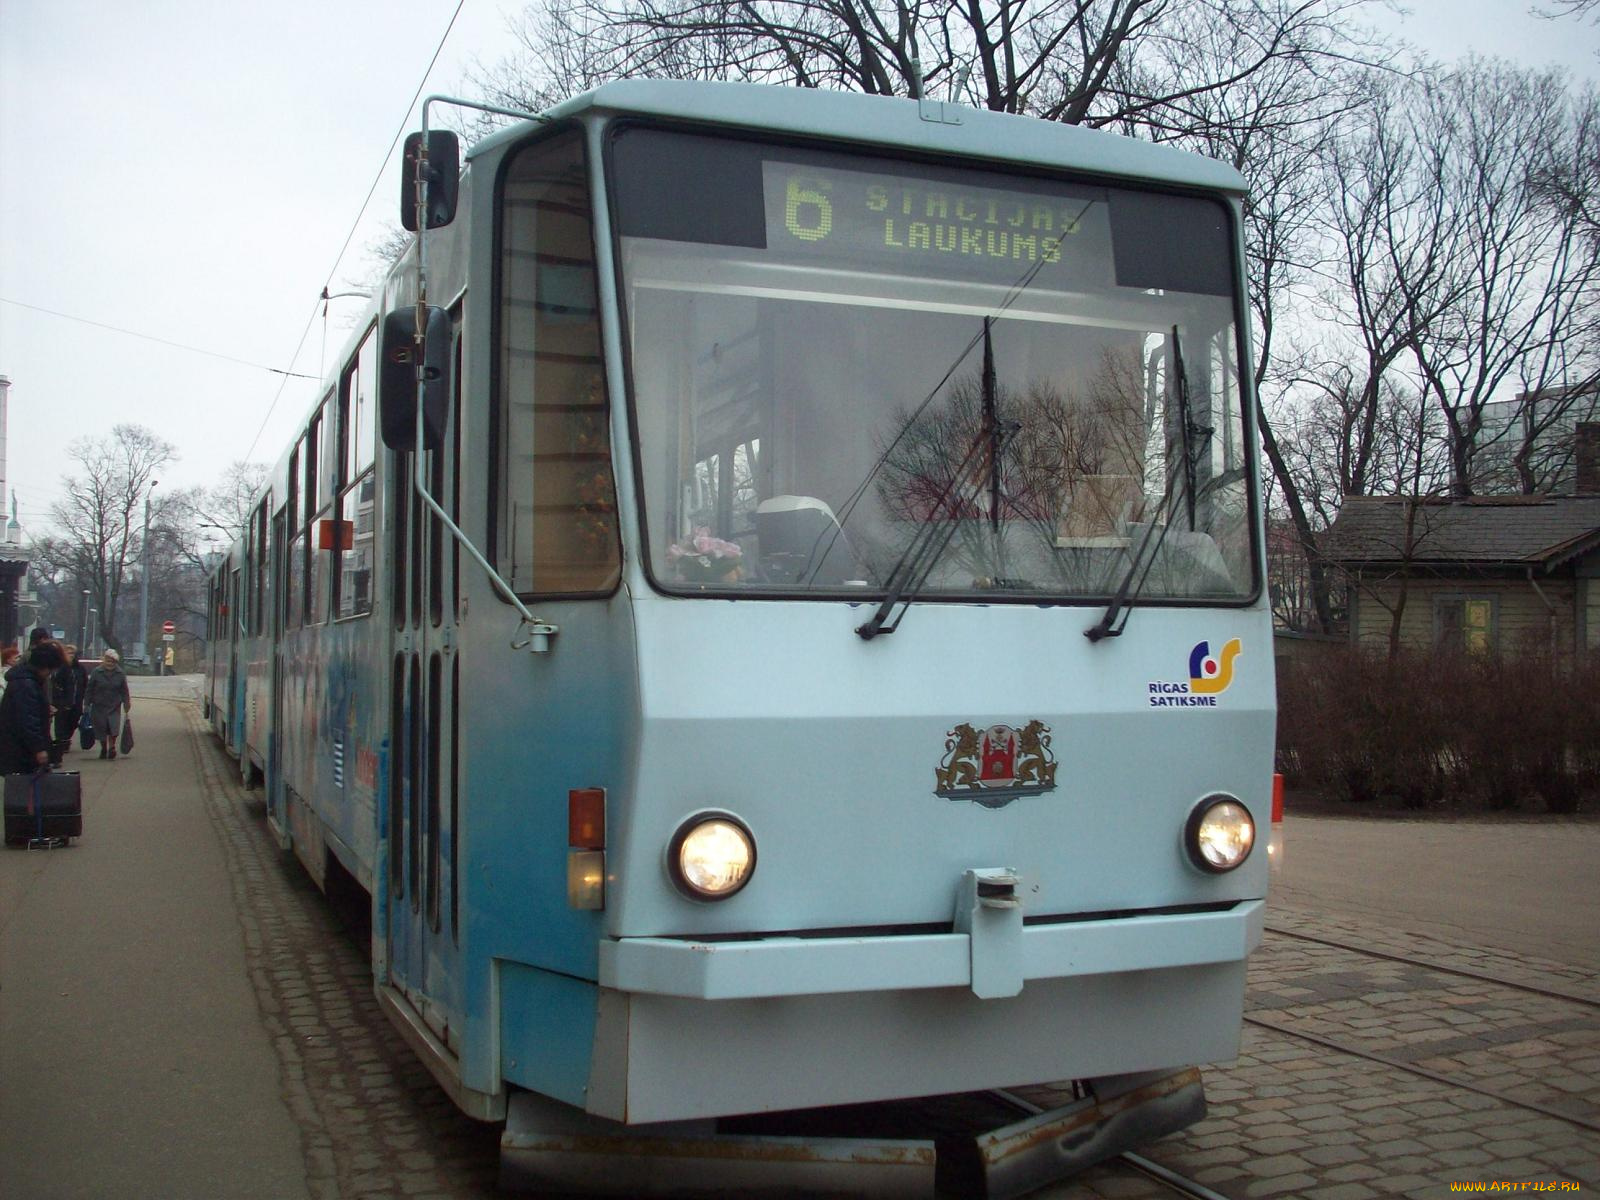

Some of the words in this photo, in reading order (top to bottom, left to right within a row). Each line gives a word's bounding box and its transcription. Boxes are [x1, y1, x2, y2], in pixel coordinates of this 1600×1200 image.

[785, 174, 833, 242] 6
[884, 218, 1062, 264] LAUKUMS
[1149, 696, 1217, 707] SATIKSME
